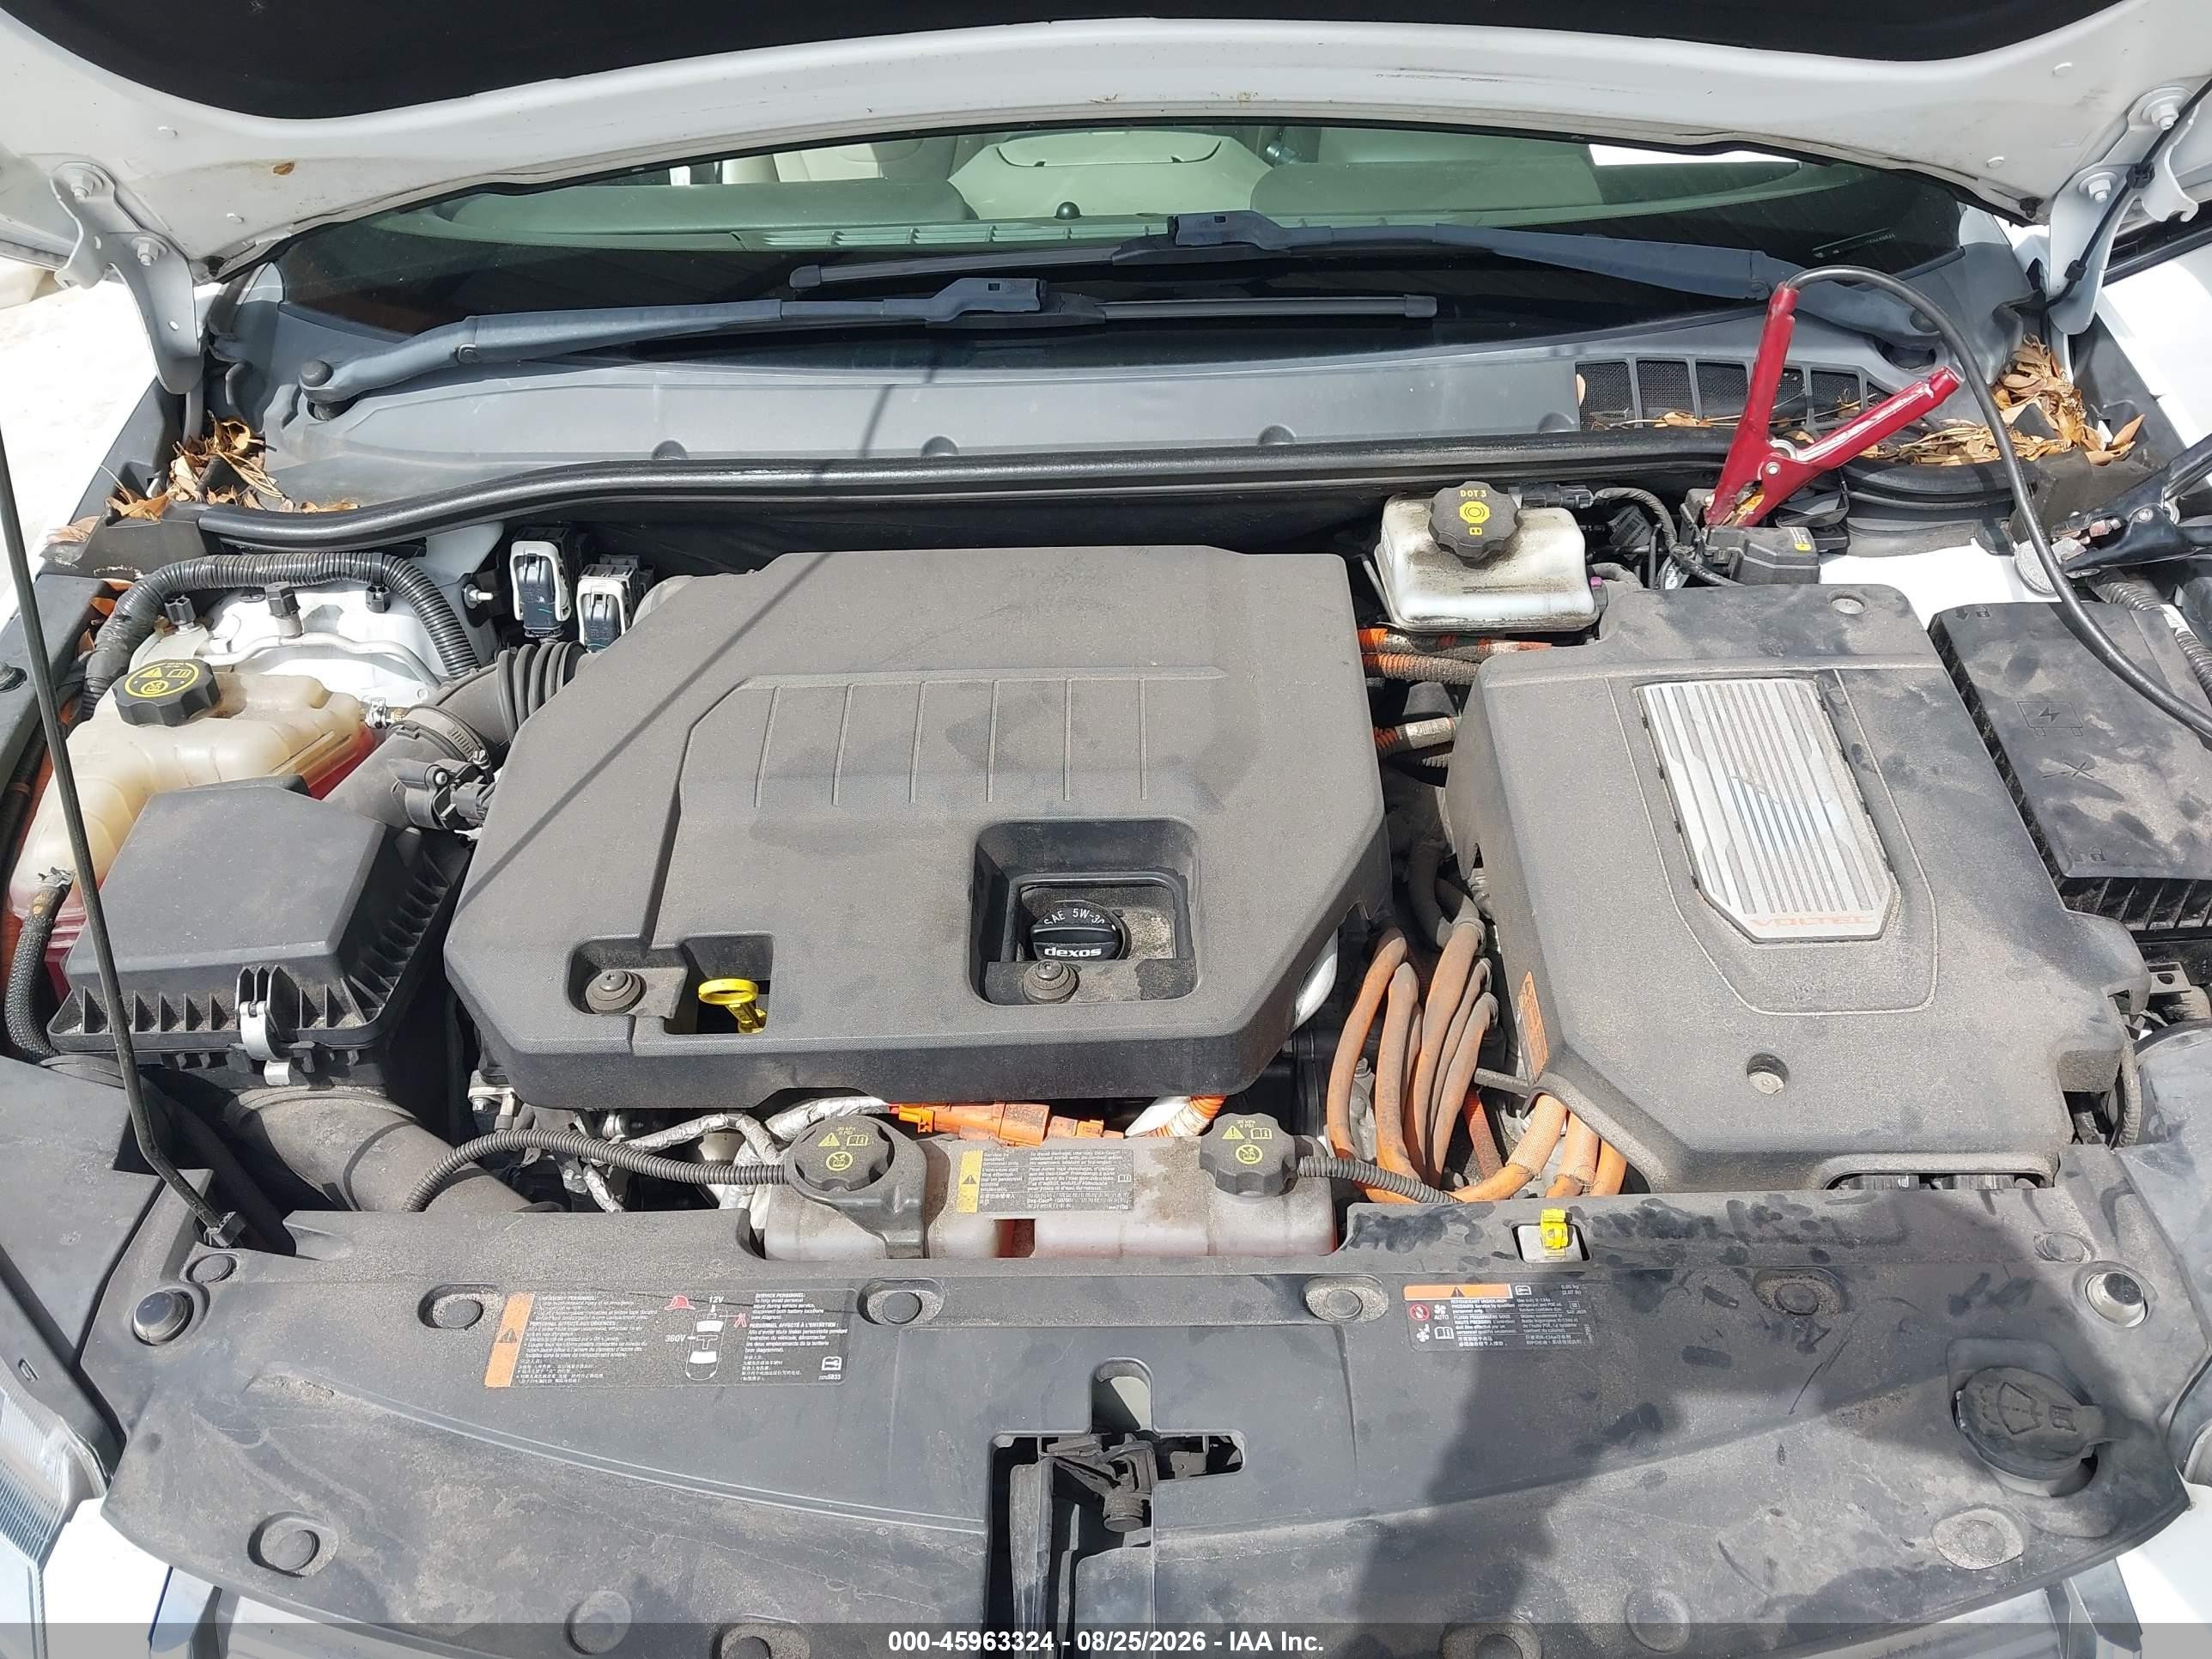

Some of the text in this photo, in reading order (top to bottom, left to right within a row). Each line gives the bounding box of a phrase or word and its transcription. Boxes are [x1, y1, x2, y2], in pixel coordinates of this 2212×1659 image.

[1043, 910, 1066, 925] SAE
[1749, 915, 1877, 927] VOLTEC
[1044, 947, 1102, 957] dexos
